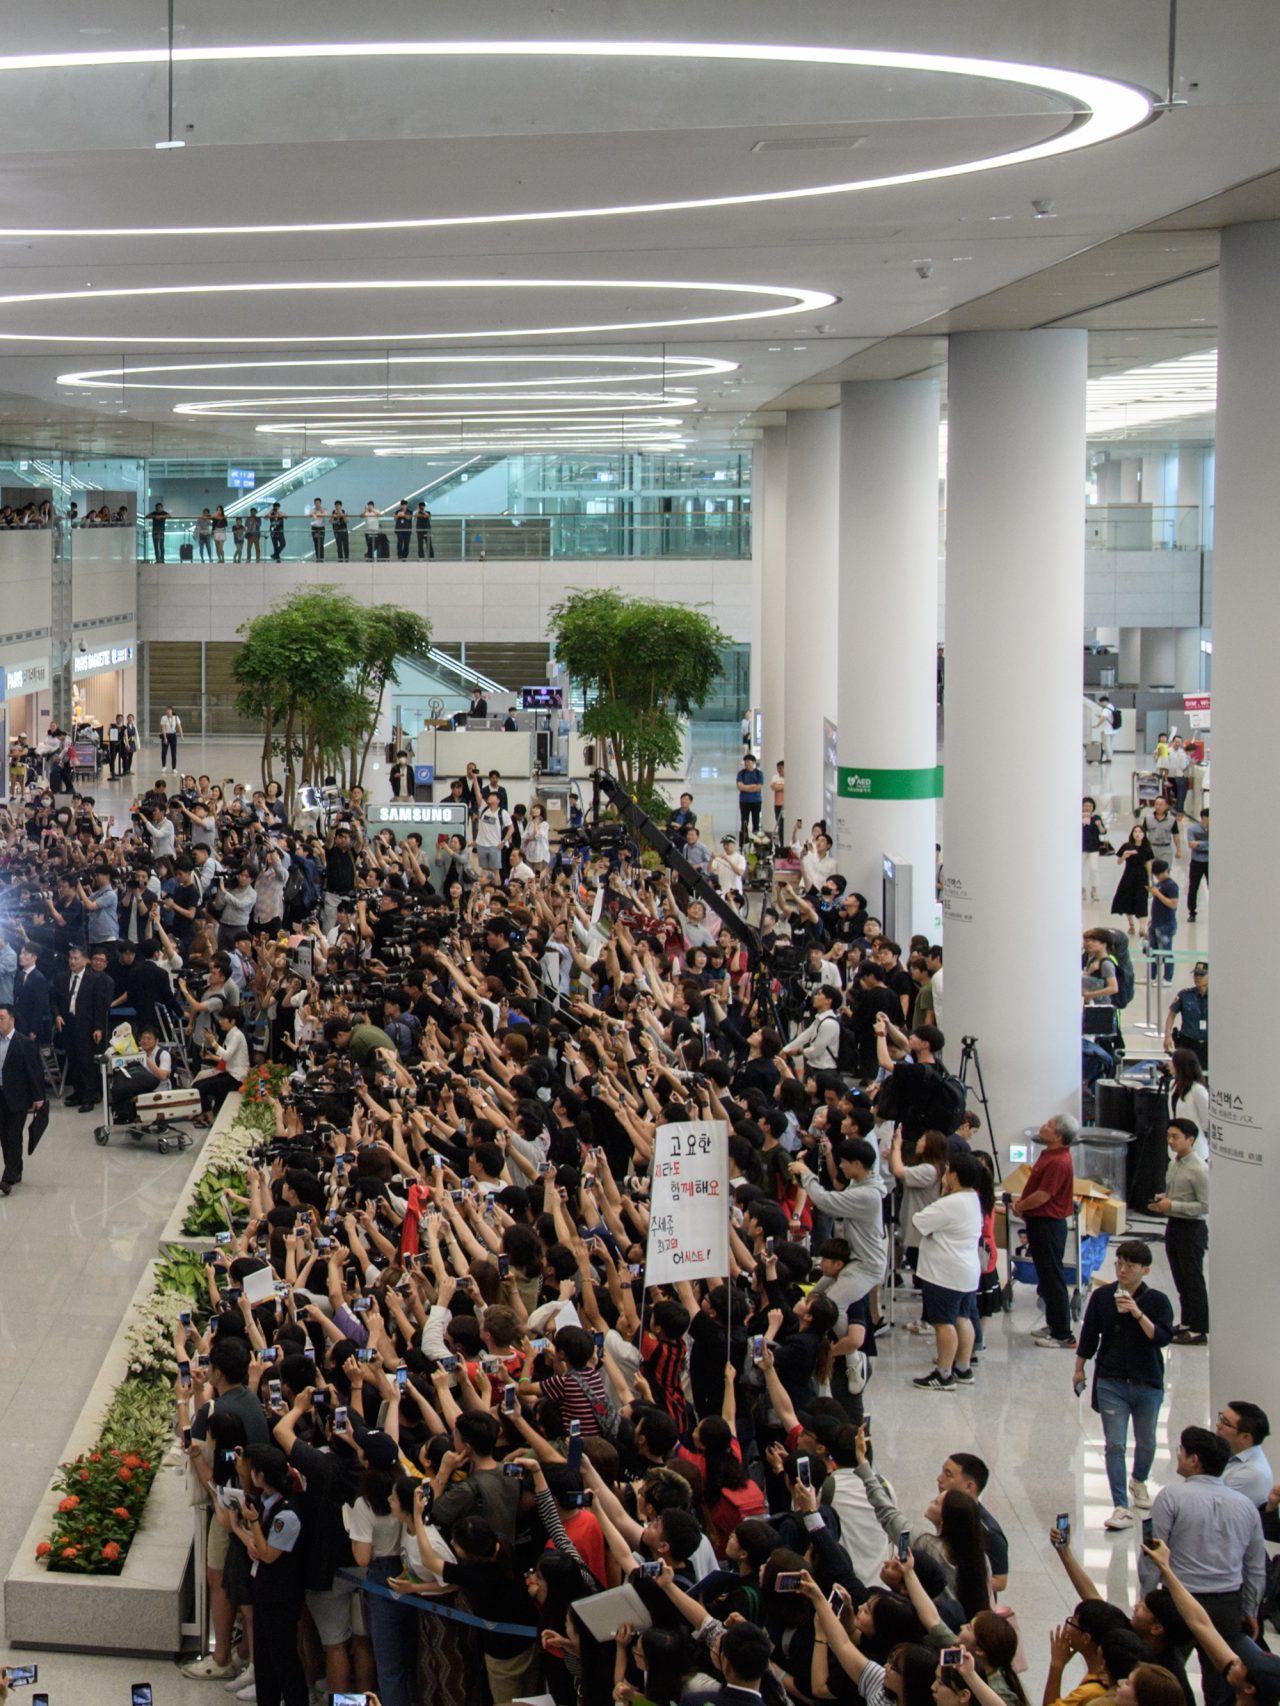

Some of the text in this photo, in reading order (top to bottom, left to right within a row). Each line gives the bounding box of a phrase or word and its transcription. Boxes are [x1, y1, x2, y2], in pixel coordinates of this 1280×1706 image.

[856, 778, 871, 786] AED
[380, 807, 452, 822] SAMSUNG
[670, 1133, 711, 1157] 고요한
[670, 1179, 720, 1201] 함께해요
[650, 1214, 676, 1237] 주세종
